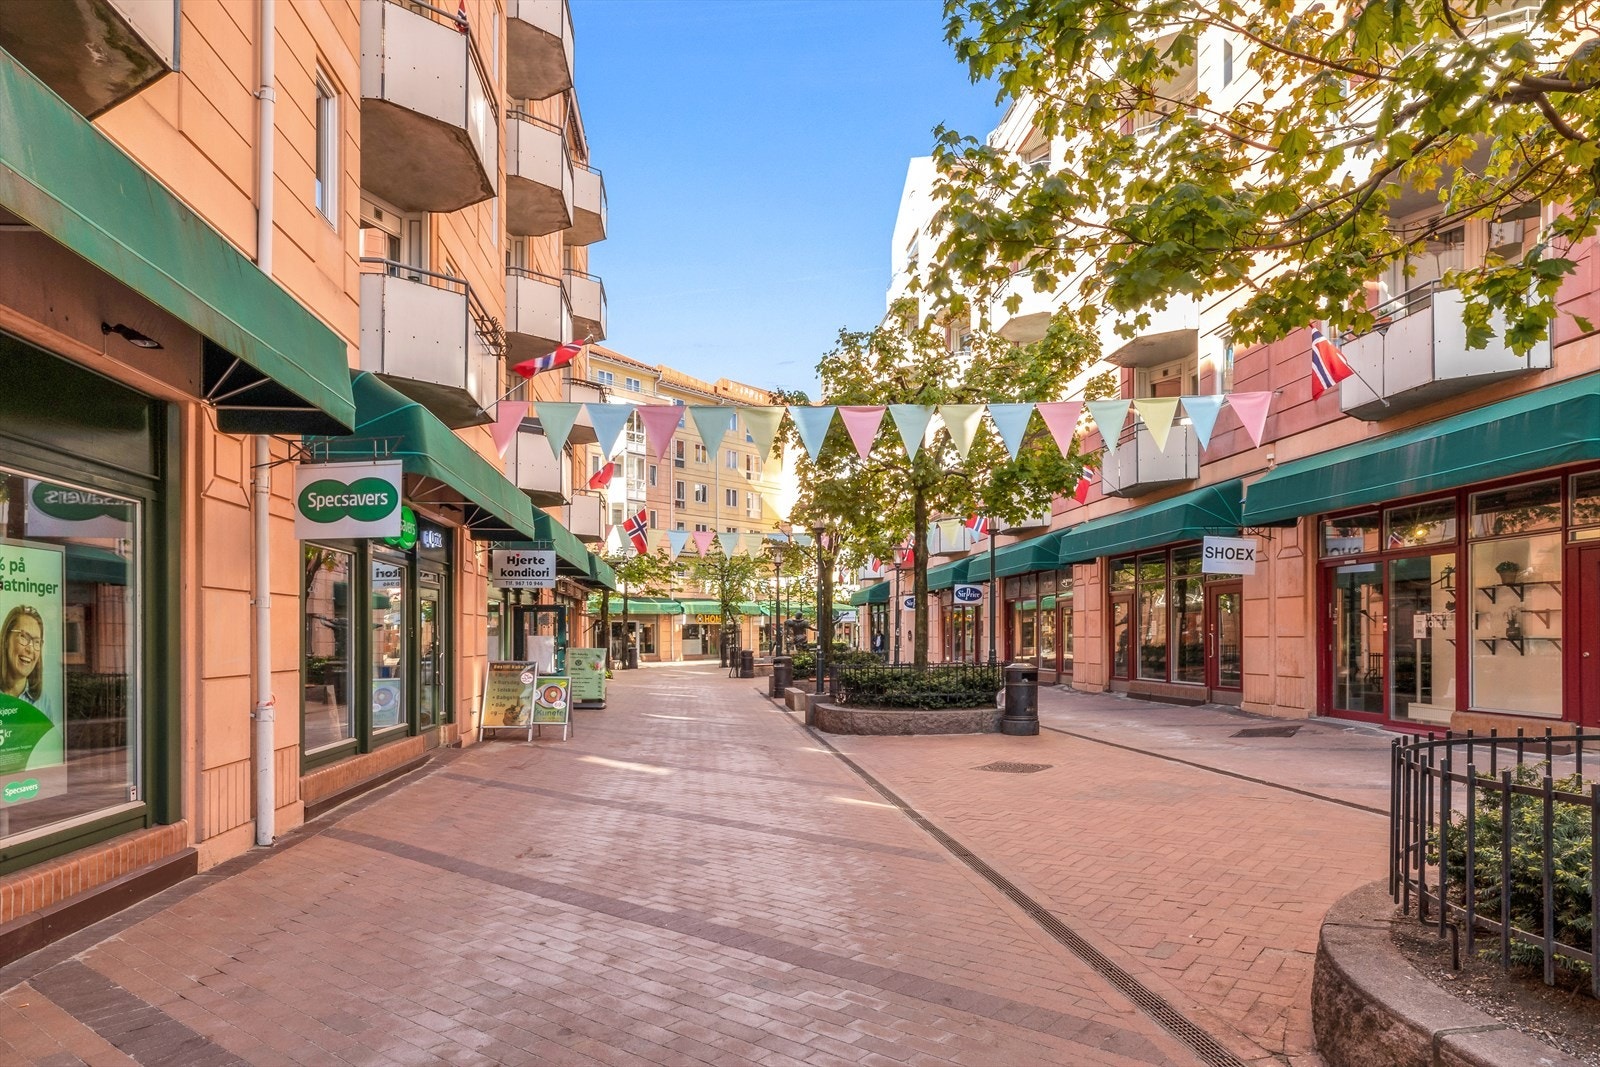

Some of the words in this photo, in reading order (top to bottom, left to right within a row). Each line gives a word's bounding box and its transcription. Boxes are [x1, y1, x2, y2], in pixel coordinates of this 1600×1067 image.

[307, 492, 388, 511] Specsavers
[507, 554, 545, 566] Hjerte
[1204, 546, 1255, 561] SHOEX
[9, 556, 26, 575] på
[500, 567, 550, 577] konditori
[4, 783, 38, 797] Specsavers
